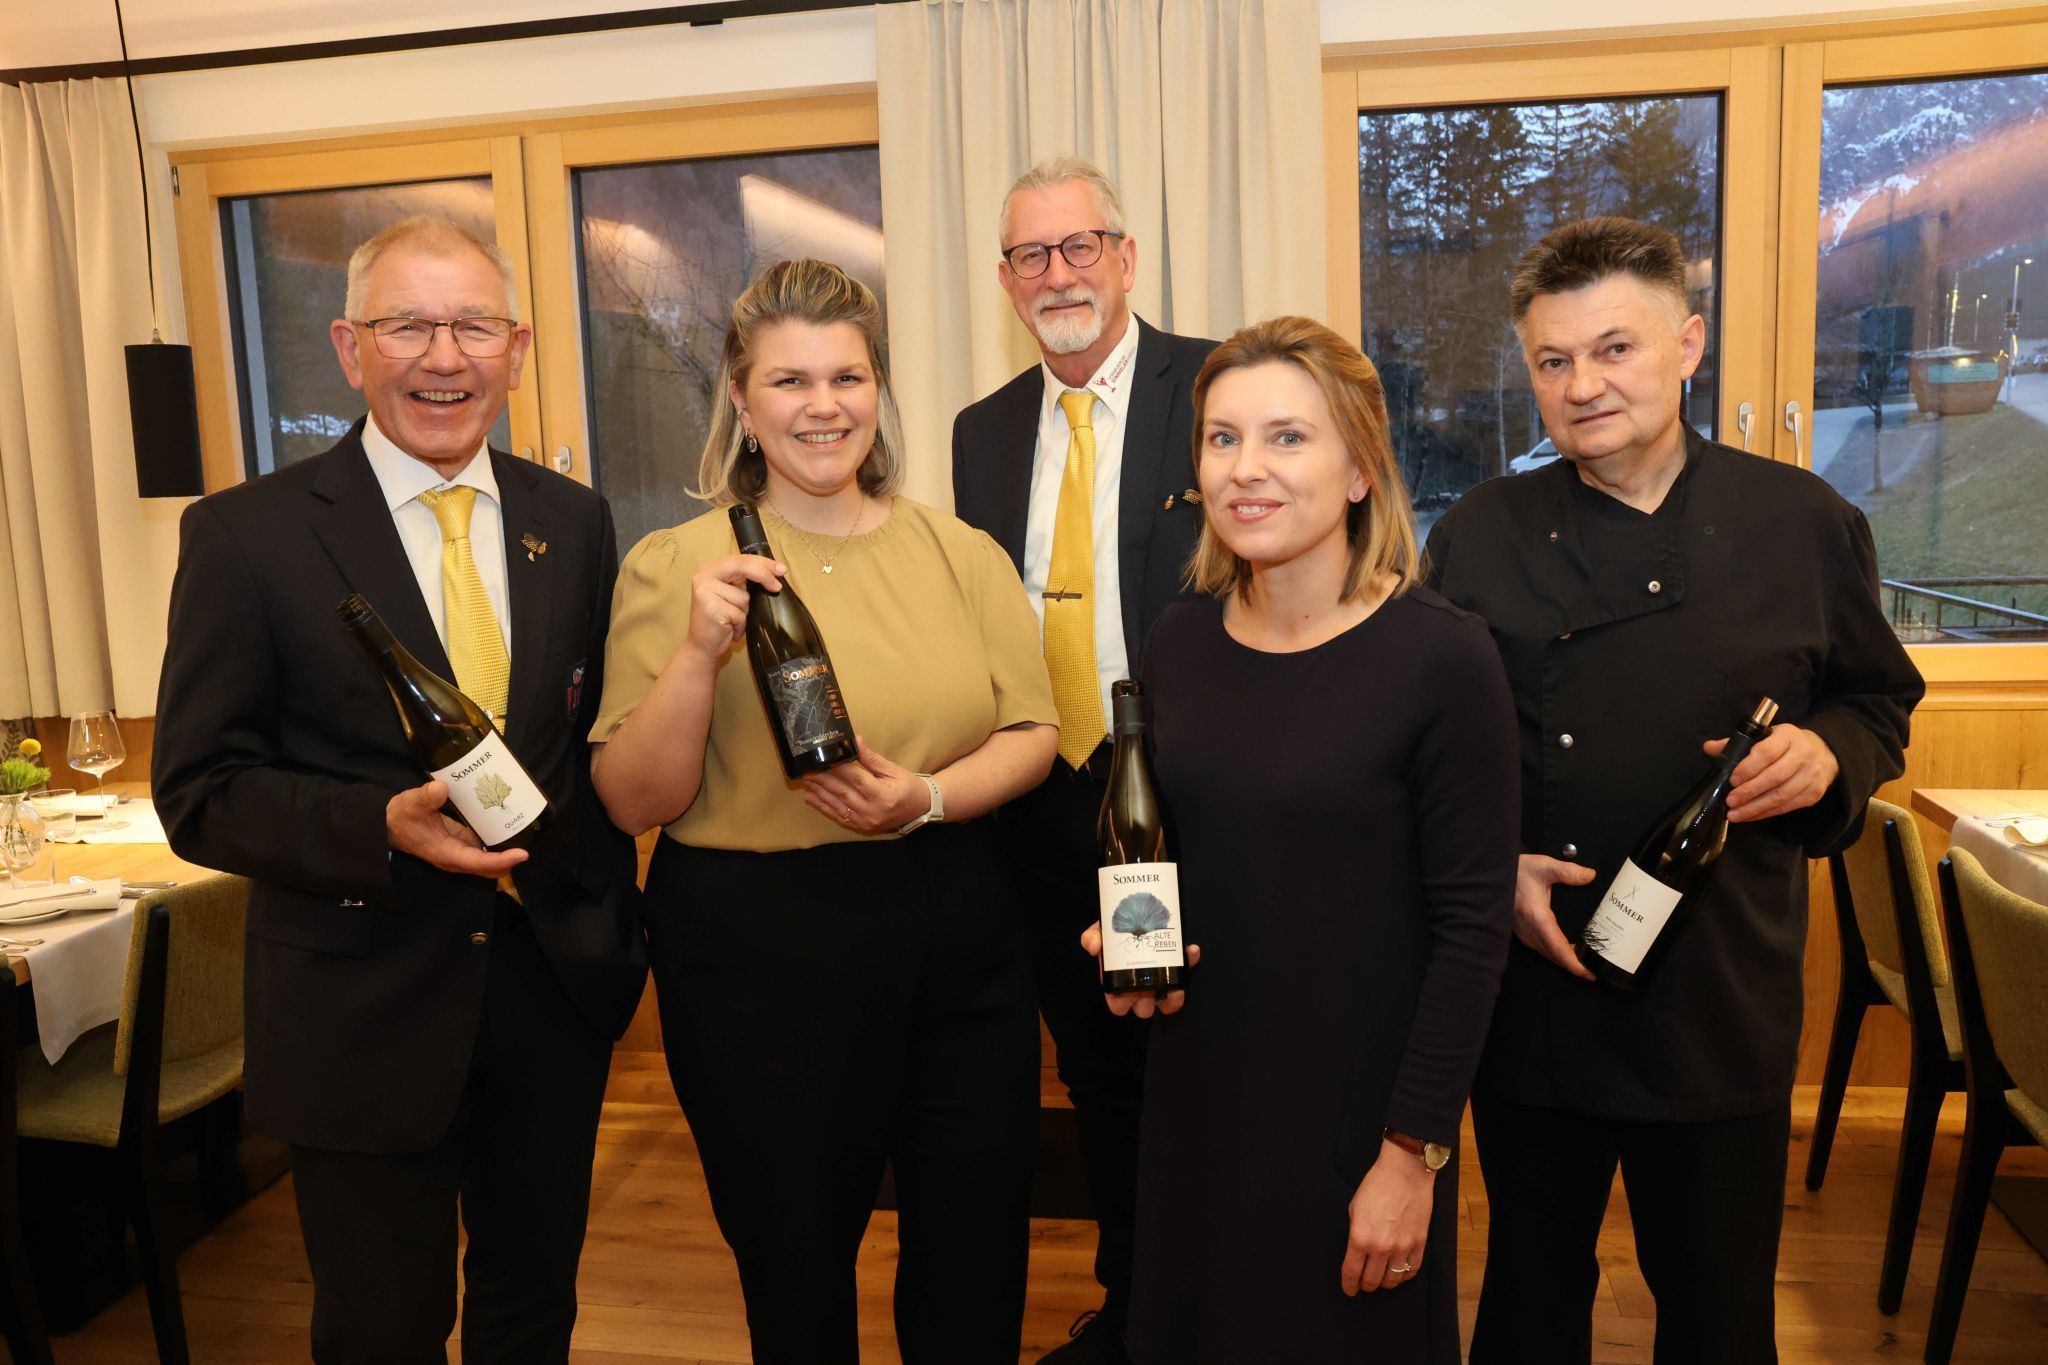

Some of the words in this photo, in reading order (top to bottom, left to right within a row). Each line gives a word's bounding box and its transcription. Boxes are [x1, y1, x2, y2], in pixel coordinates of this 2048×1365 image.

[504, 812, 525, 830] QUARZ
[1154, 931, 1171, 940] ALTE
[1154, 941, 1177, 949] REBEN
